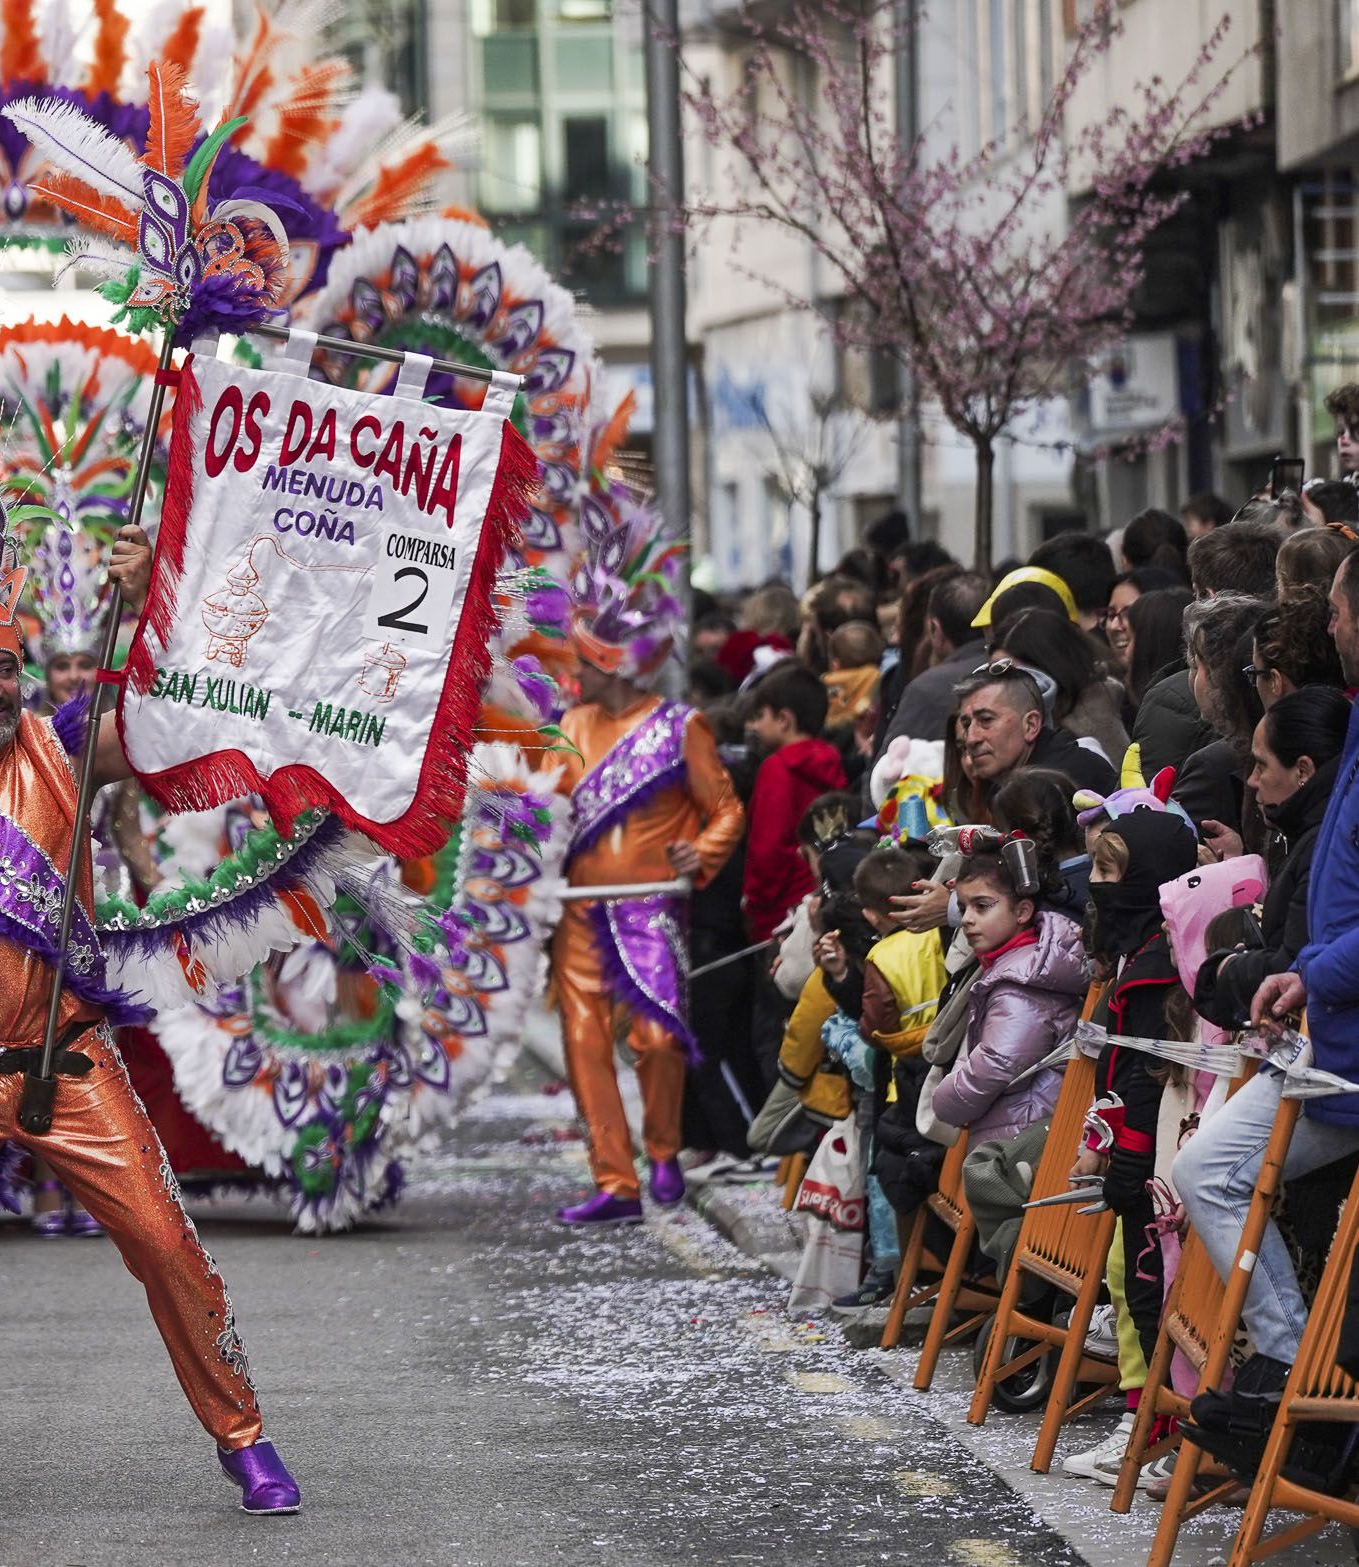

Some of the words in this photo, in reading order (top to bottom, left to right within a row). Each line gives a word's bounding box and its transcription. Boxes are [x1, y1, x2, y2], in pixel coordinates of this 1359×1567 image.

[205, 385, 270, 478] OS
[279, 400, 336, 467] DA
[350, 415, 462, 528] CAÑA
[262, 464, 384, 511] MENUDA
[273, 507, 355, 546] COÑA
[386, 533, 457, 571] COMPARSA
[377, 566, 429, 635] 2
[149, 667, 197, 705] SAN
[202, 675, 272, 721] XULIAN
[309, 701, 386, 747] MARIN
